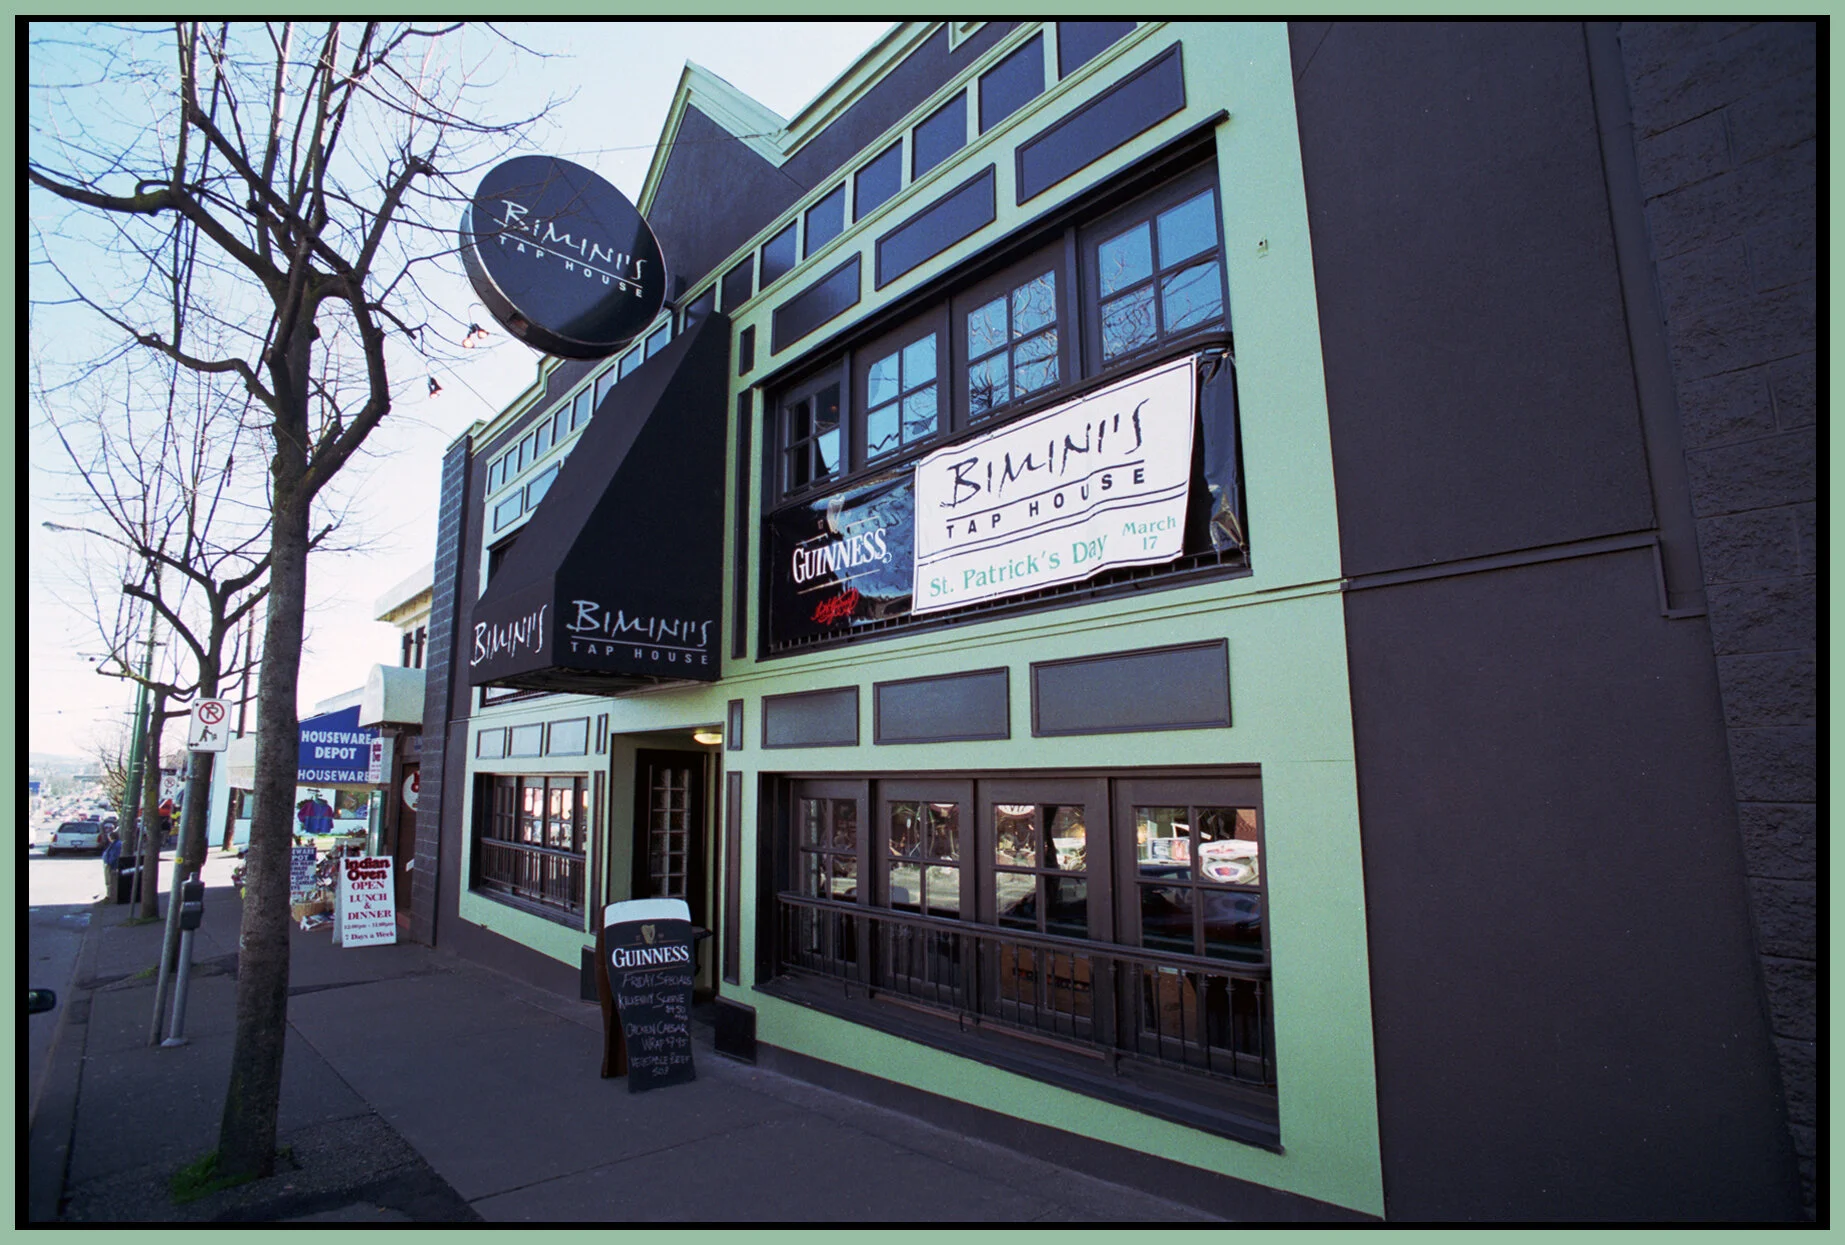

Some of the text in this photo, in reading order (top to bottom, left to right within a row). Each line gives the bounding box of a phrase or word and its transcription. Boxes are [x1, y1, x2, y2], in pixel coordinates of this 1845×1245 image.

[499, 234, 643, 298] TAP HOUSE
[939, 398, 1149, 508] BIMINI'S
[946, 467, 1145, 538] TAP HOUSE
[1121, 515, 1177, 537] March
[1142, 535, 1158, 550] 17
[793, 528, 886, 583] GUINNESS
[929, 533, 1108, 597] St. Patrick's Day
[566, 600, 712, 647] BIMINI'S
[471, 604, 547, 666] BIMINI'S
[570, 641, 708, 665] TAP HOUSE
[301, 730, 372, 745] HOUSEWARE
[314, 746, 357, 760] DEPOT
[345, 857, 391, 870] Indian
[347, 869, 387, 881] Oven
[351, 881, 385, 890] OPEN
[350, 893, 387, 903] LUNCH
[348, 910, 392, 920] DINNER
[612, 945, 690, 968] GUINNESS
